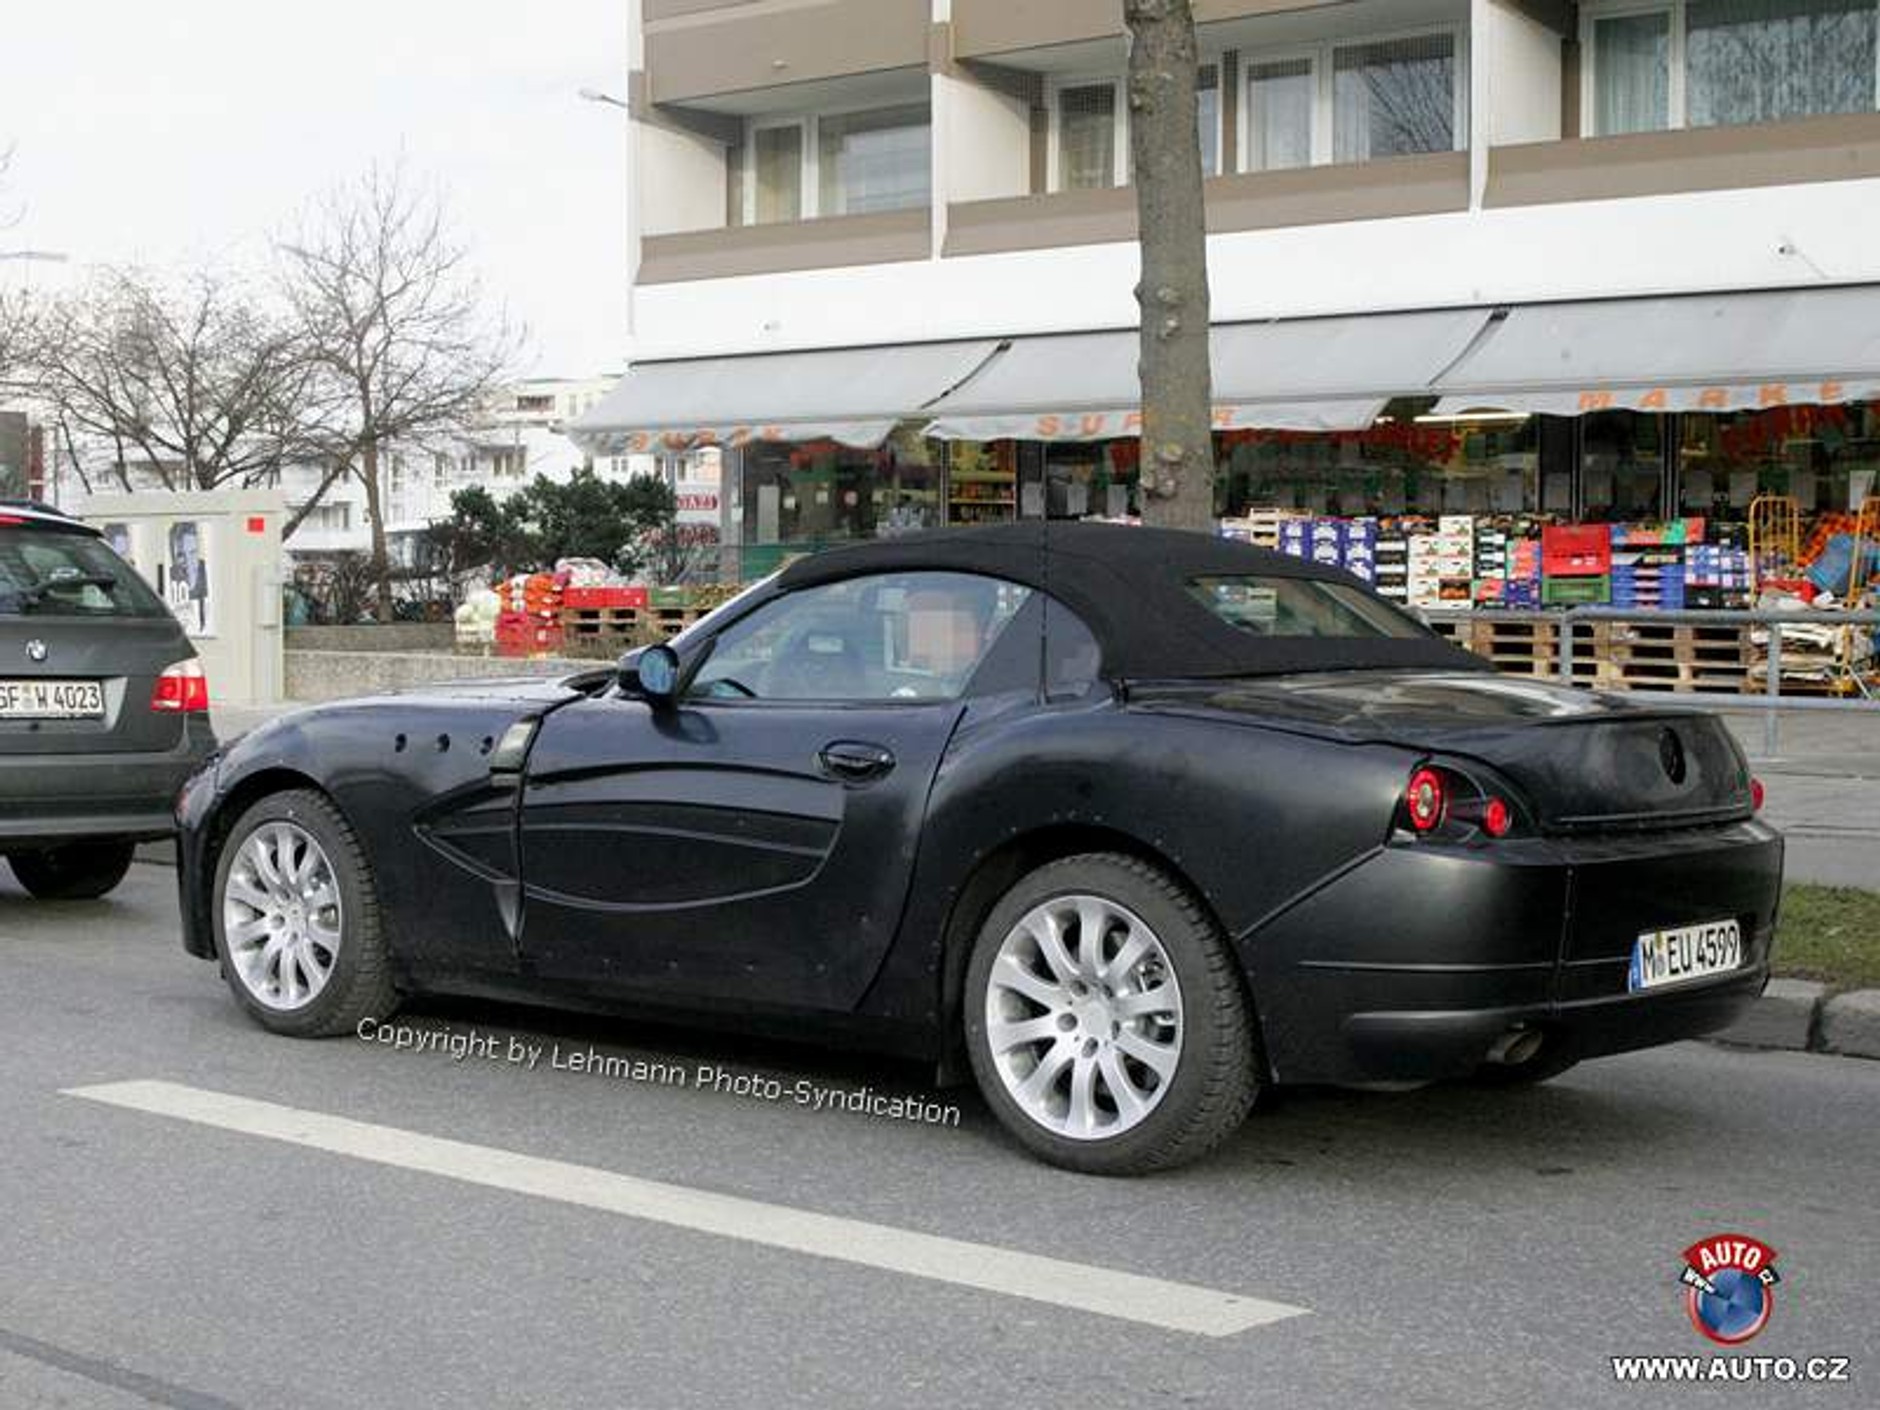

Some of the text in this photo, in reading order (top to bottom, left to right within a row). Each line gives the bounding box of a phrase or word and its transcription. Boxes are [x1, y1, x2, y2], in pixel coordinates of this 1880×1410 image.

[53, 685, 100, 709] 4023
[1642, 925, 1738, 979] M EU 4599
